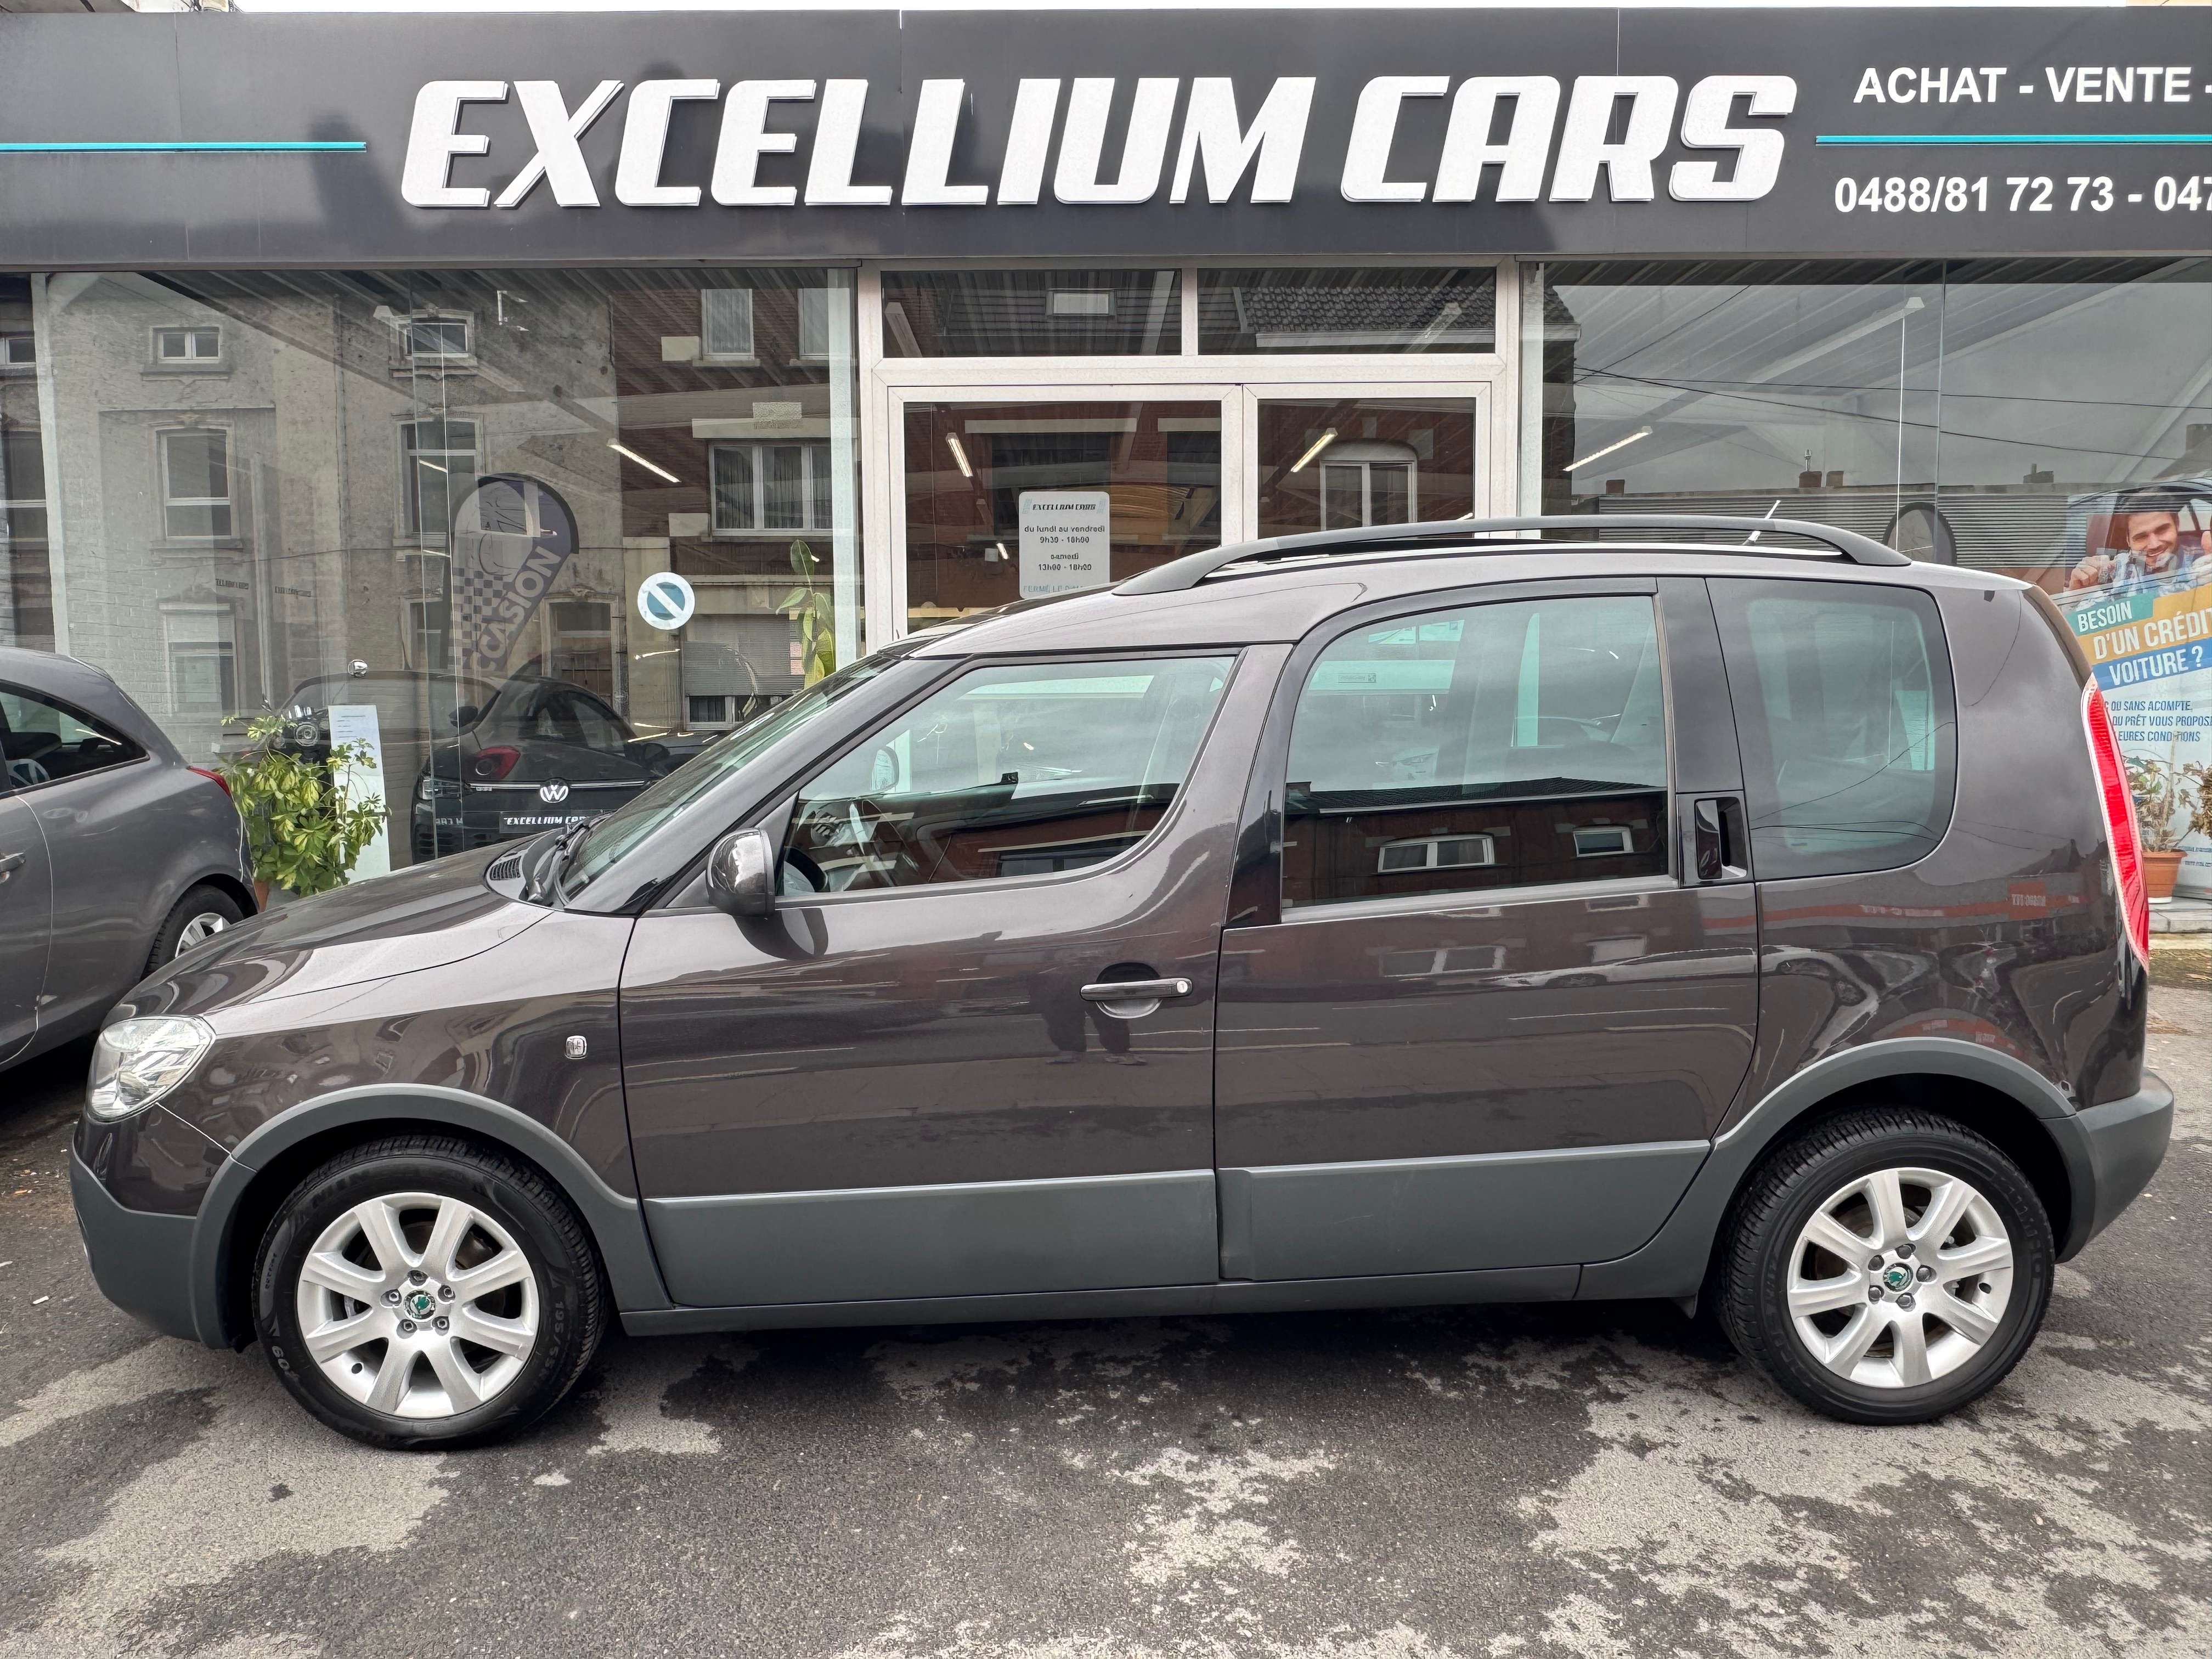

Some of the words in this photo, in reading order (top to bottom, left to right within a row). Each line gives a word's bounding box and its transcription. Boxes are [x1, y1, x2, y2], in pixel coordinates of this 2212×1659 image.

[1853, 66, 2007, 104] ACHAT
[2019, 84, 2034, 94] -
[2045, 66, 2192, 103] VENTE
[401, 76, 1316, 208] EXCELLIUM
[1340, 75, 1797, 203] CARS
[1834, 176, 1988, 213] 0488/81
[2006, 176, 2053, 212] 72
[2067, 176, 2114, 212] 73
[2127, 192, 2142, 204] -
[2077, 601, 2132, 633] BESOIN
[2093, 626, 2141, 659] D'UN
[2108, 648, 2189, 686] VOITURE
[2191, 645, 2204, 668] ?
[2124, 701, 2146, 711] SANS
[2125, 714, 2147, 726] PRÊT
[2149, 716, 2173, 726] VOUS
[506, 816, 563, 825] EXCELLIUM
